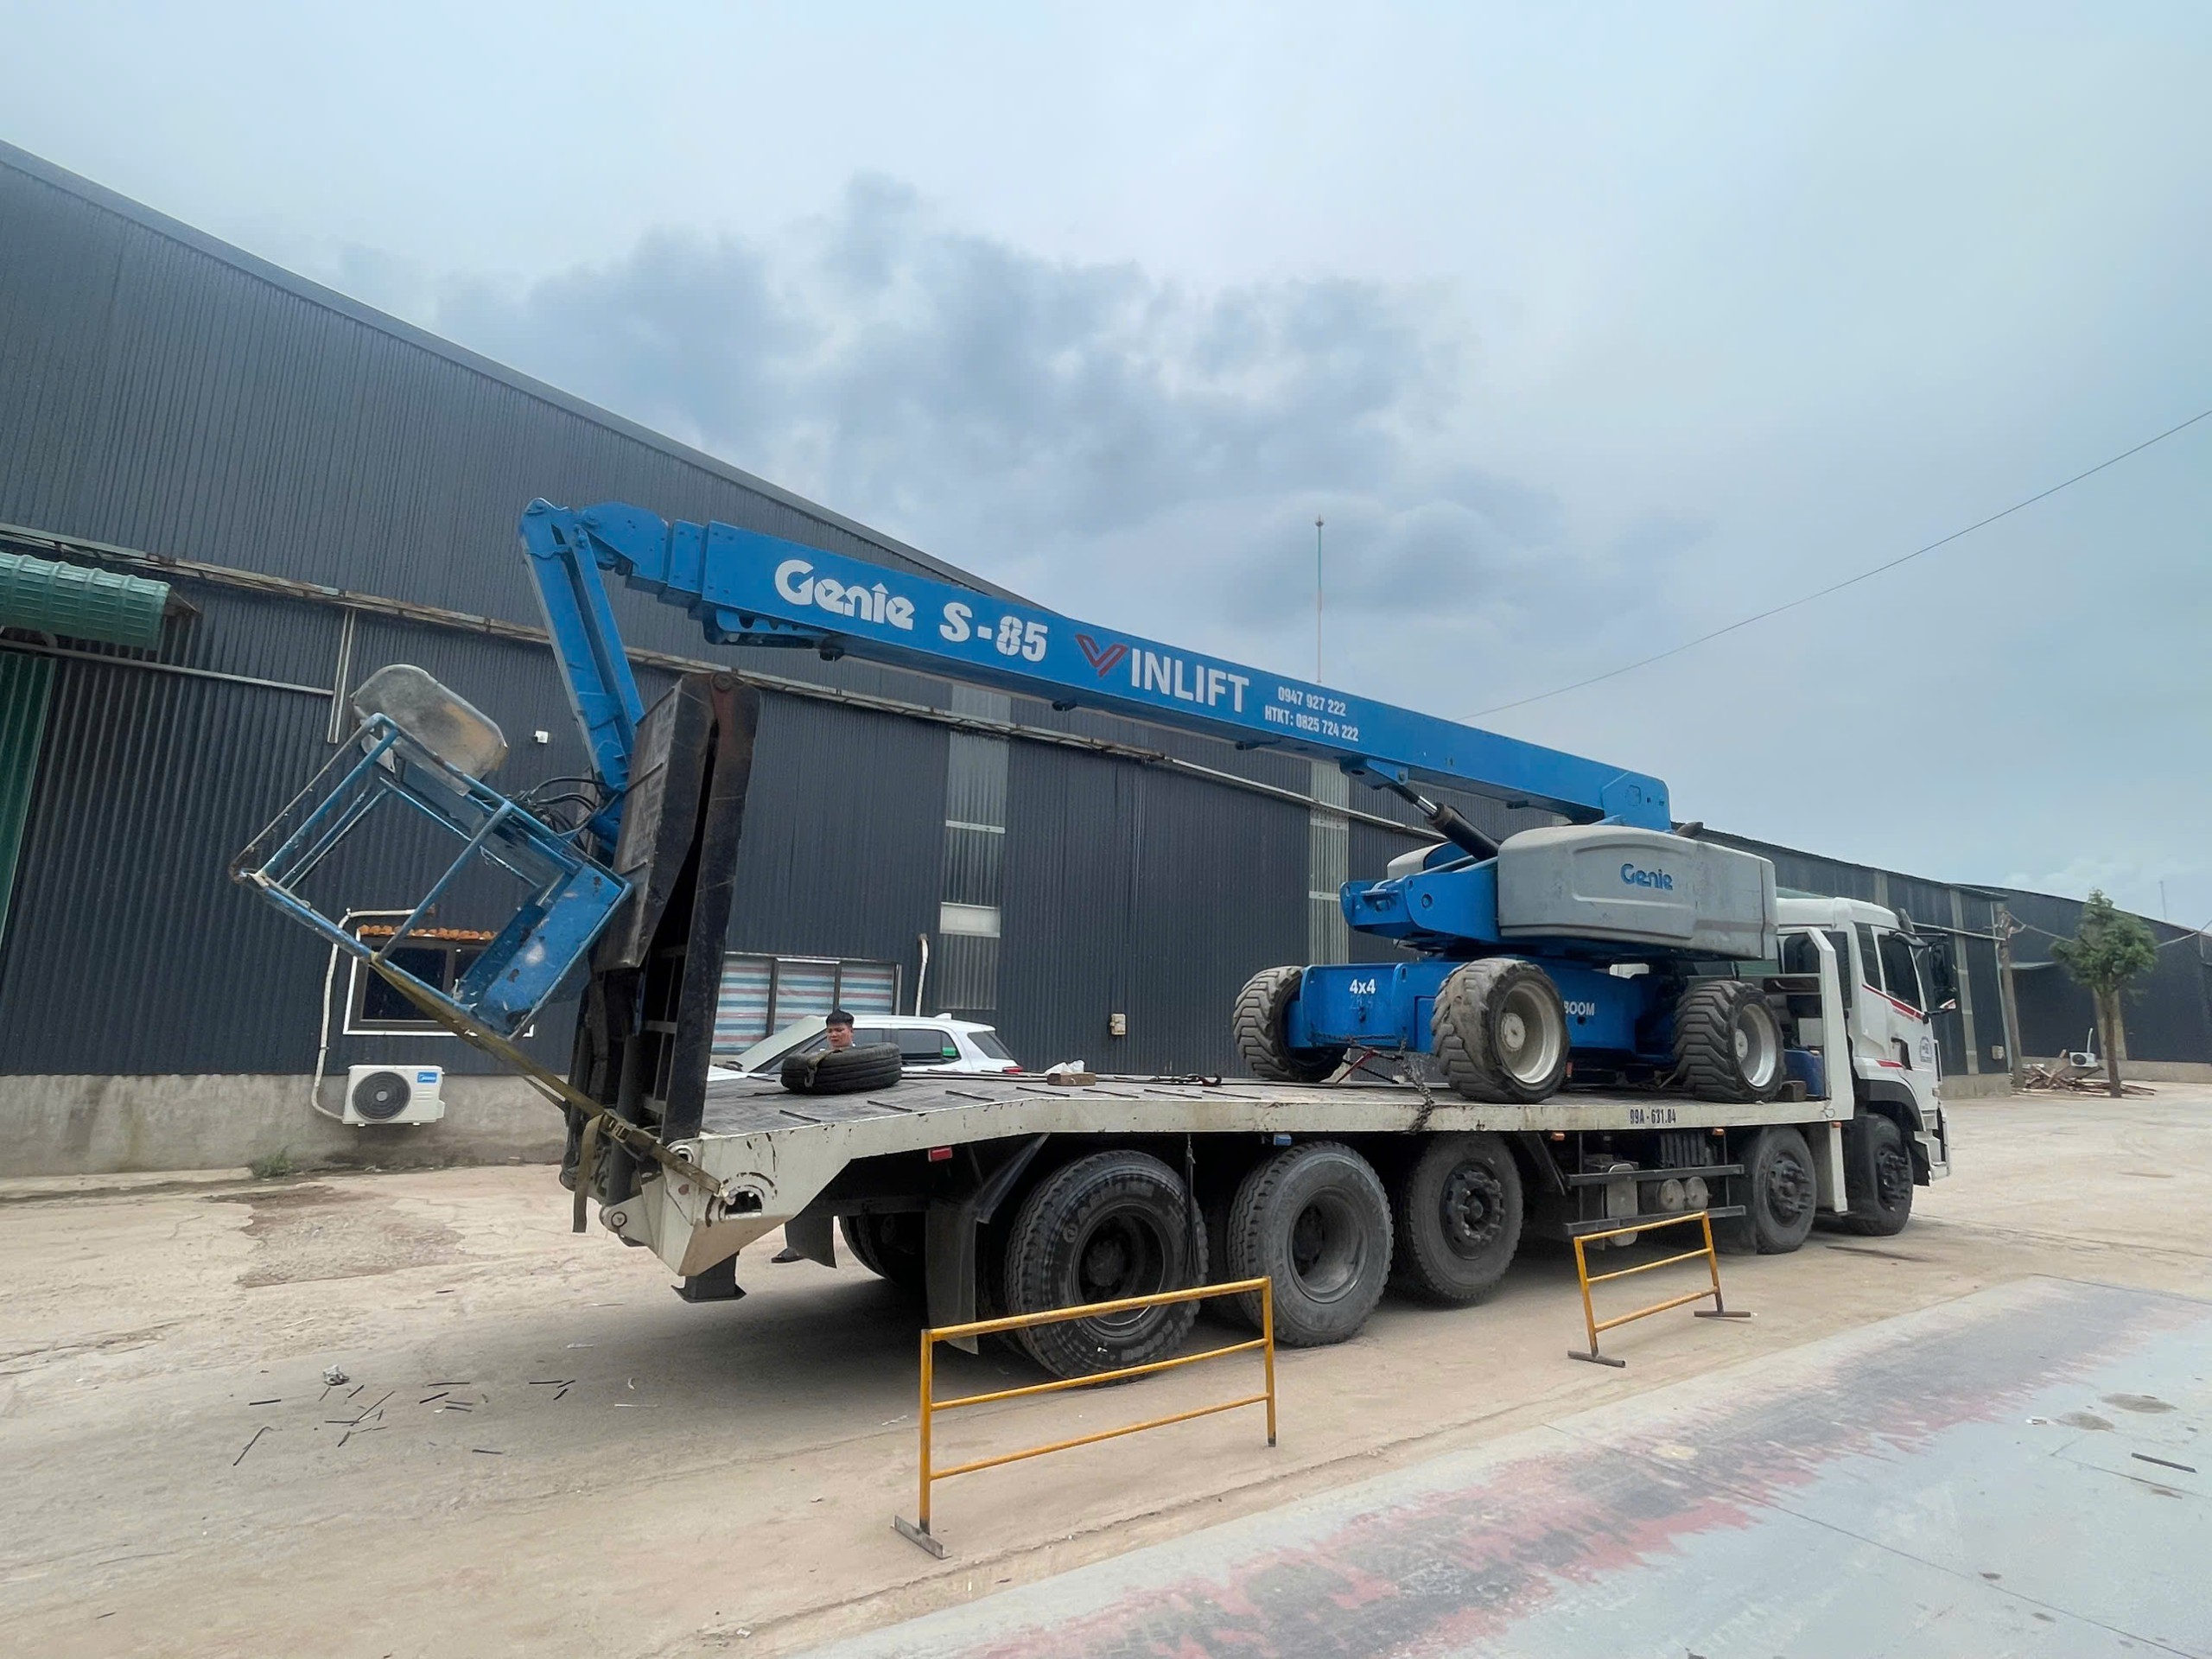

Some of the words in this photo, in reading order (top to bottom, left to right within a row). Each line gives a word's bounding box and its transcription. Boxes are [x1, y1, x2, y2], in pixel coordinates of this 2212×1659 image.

[774, 559, 915, 631] Genie
[939, 602, 1049, 663] S-85
[1278, 686, 1303, 706] 0947
[1306, 694, 1325, 711] 927
[1327, 699, 1346, 717] 222
[1265, 705, 1294, 727] HTKT:
[1296, 714, 1319, 733] 0825
[1322, 720, 1339, 737] 724
[1341, 725, 1359, 741] 222
[1620, 863, 1673, 891] Genie
[1349, 978, 1376, 995] 4x4
